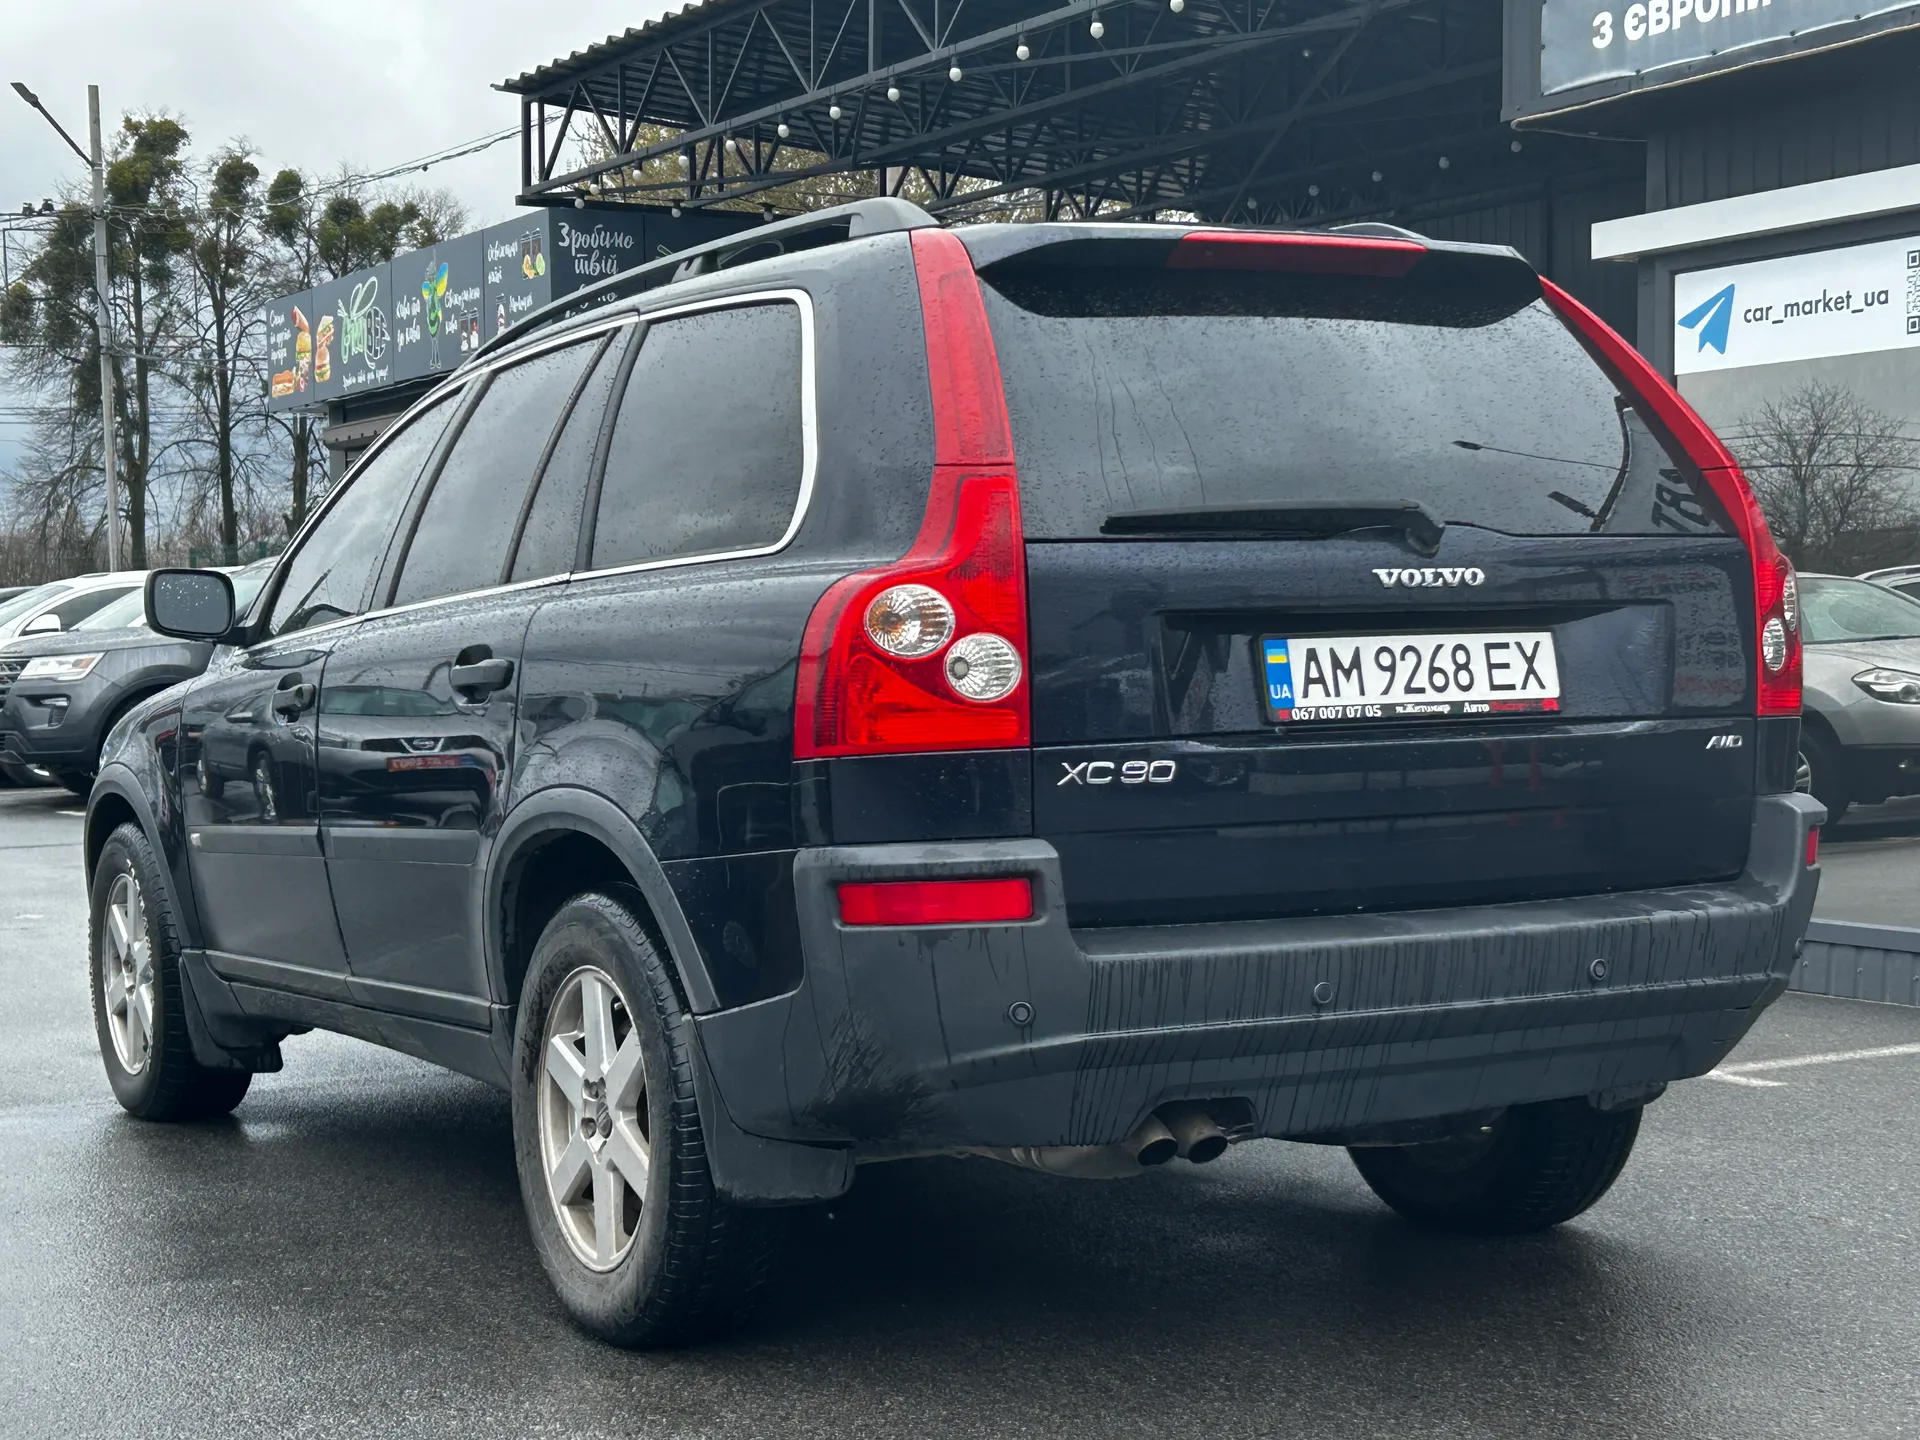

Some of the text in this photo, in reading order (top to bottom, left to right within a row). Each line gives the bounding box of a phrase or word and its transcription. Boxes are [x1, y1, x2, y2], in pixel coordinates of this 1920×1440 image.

[1623, 0, 1772, 42] ЄВРО
[1743, 289, 1889, 324] car_market_ua
[1372, 568, 1485, 589] VOLVO
[1302, 640, 1546, 699] AM 9268 EX
[1269, 684, 1292, 699] UA
[1291, 708, 1316, 720] 067
[1319, 707, 1342, 719] 007
[1346, 706, 1362, 718] 07
[1365, 705, 1382, 717] 05
